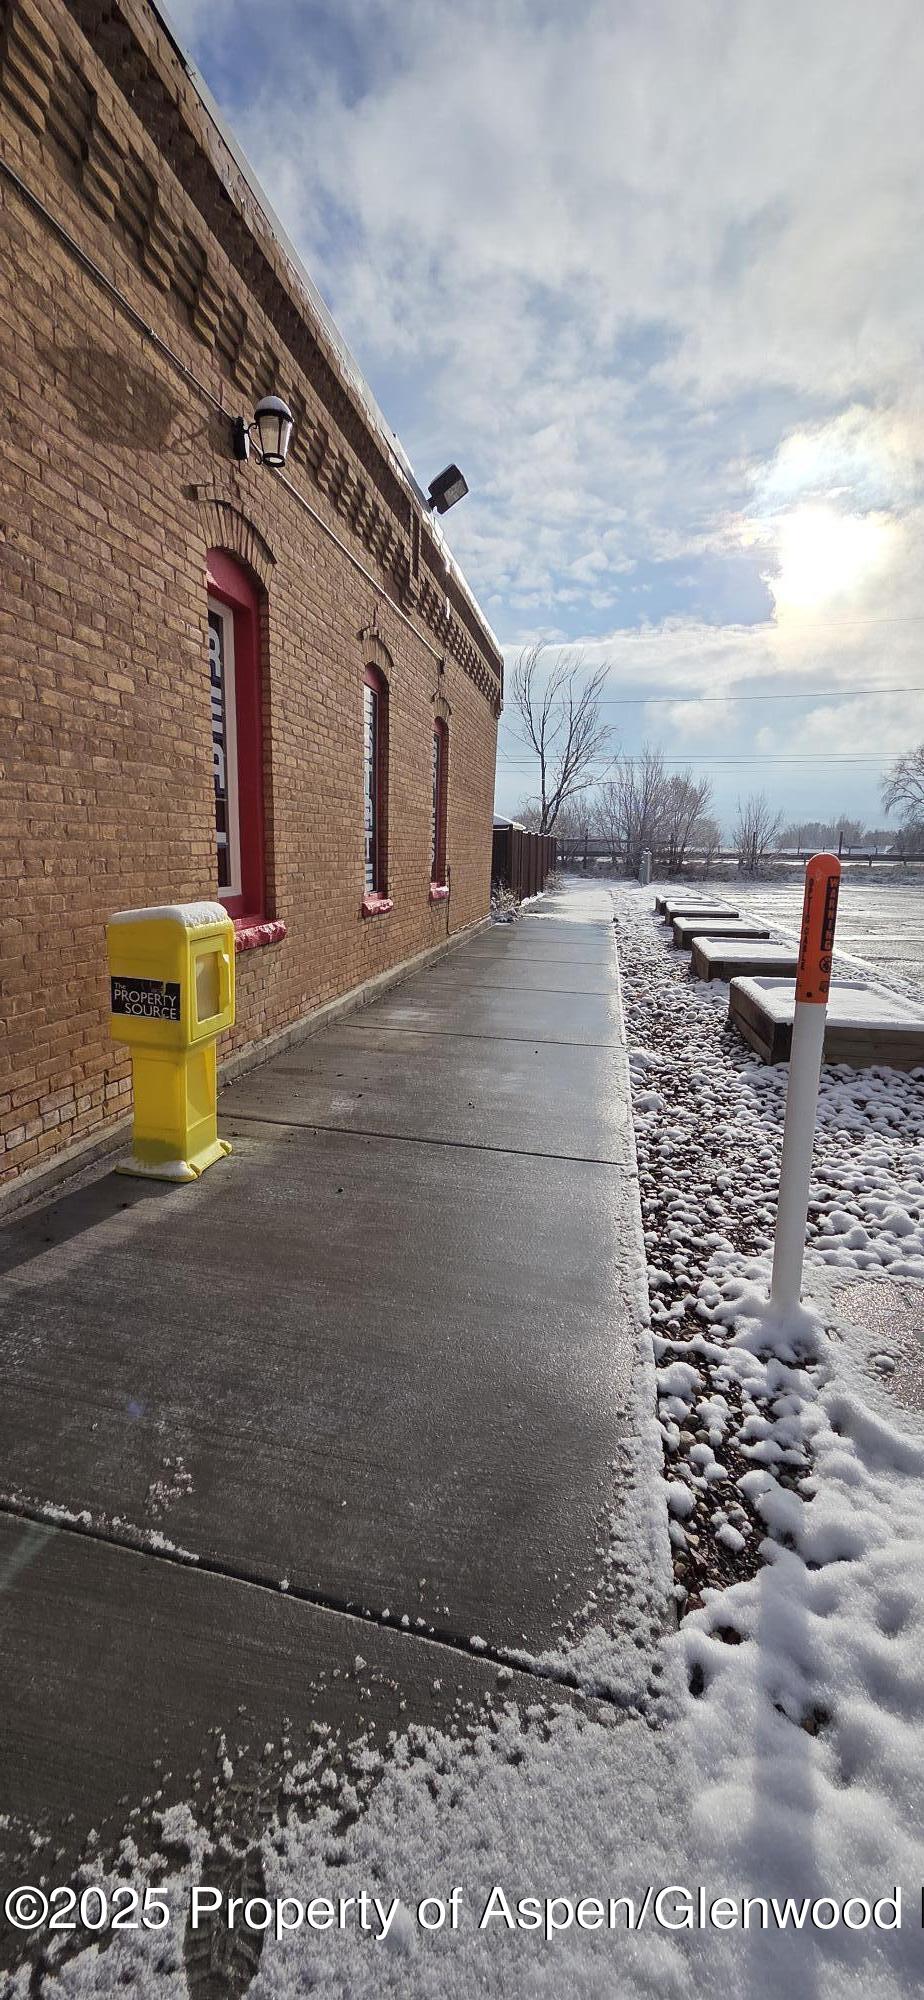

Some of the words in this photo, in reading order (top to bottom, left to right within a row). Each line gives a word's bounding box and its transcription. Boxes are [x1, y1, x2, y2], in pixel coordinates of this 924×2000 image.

[823, 877, 840, 950] WARNING
[114, 982, 126, 990] The
[114, 989, 177, 1007] PROPERTY
[125, 1003, 177, 1019] SOURCE
